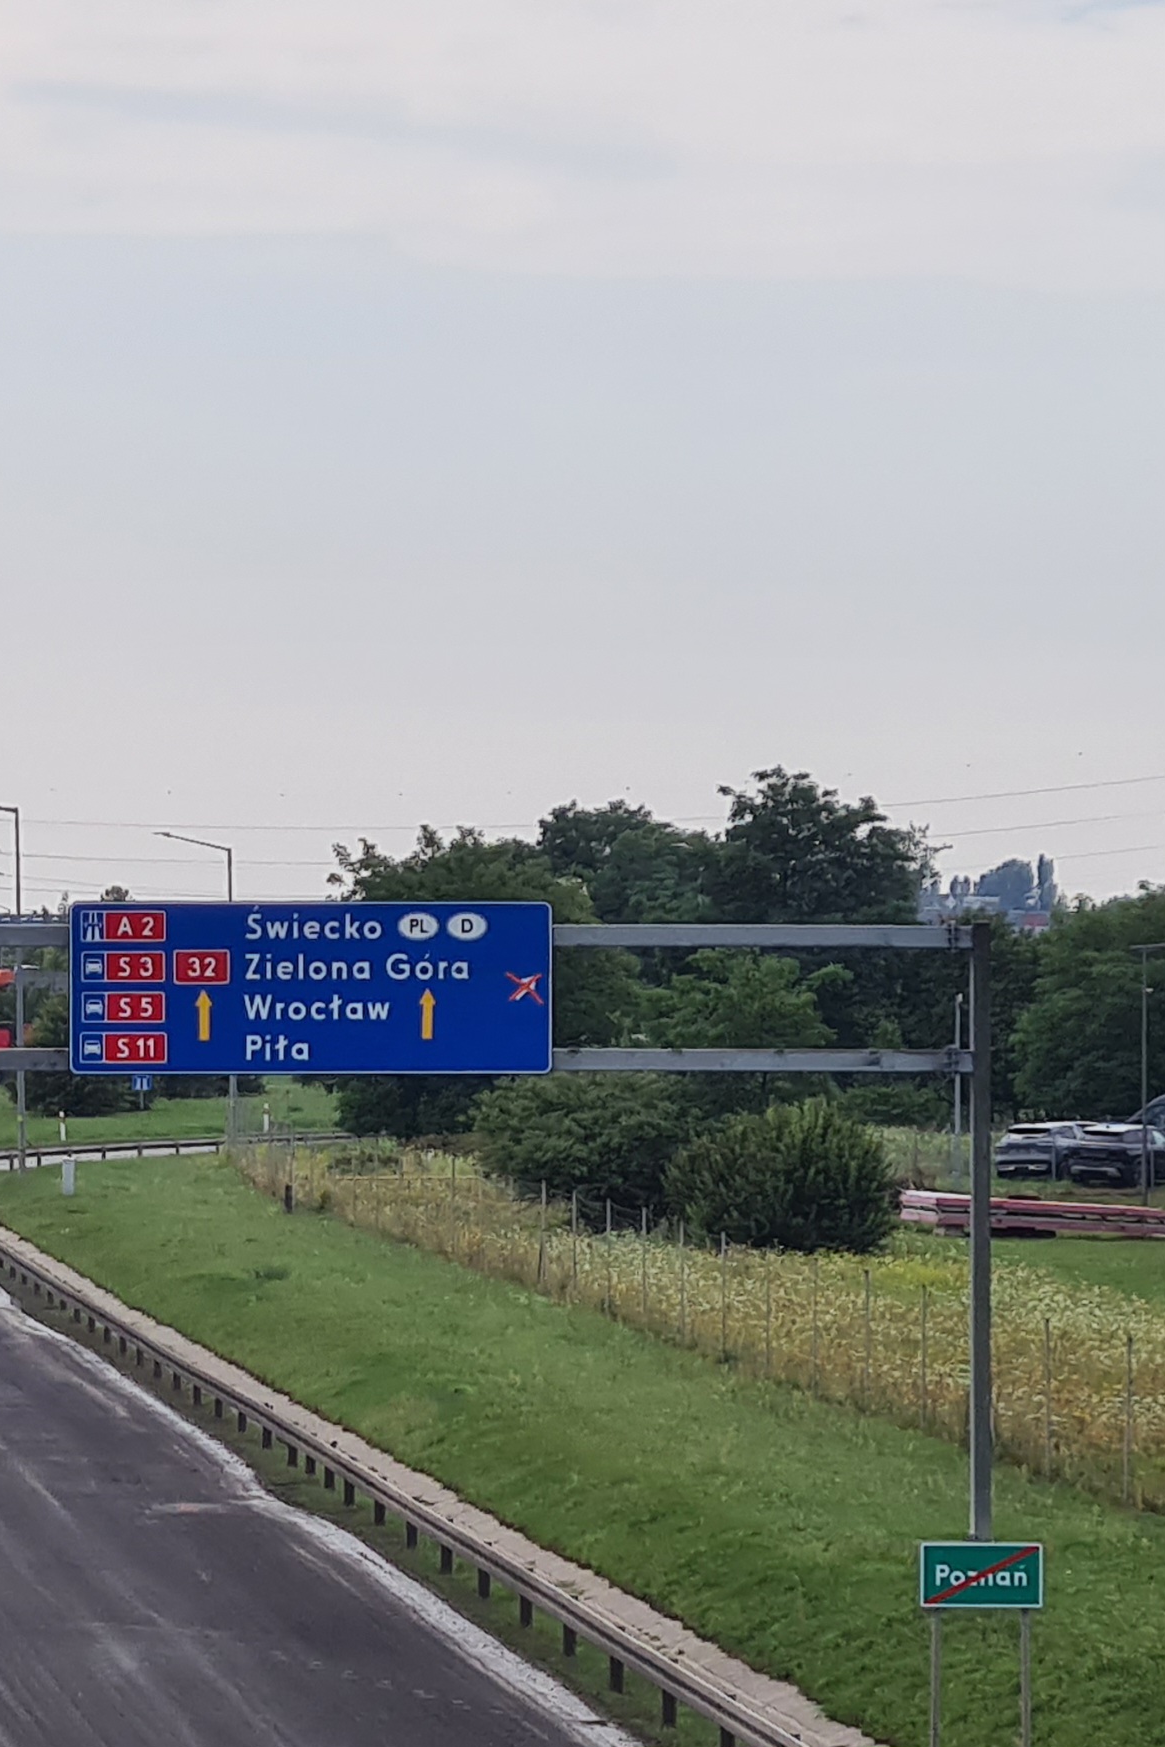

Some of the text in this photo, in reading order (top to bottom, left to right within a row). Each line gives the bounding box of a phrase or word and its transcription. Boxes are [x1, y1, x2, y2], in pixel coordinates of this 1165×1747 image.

[245, 905, 474, 940] Świecko PL D
[187, 957, 217, 977] 32
[245, 950, 469, 980] Zielona Góra
[244, 994, 389, 1021] Wrocław
[246, 1035, 309, 1061] Piła
